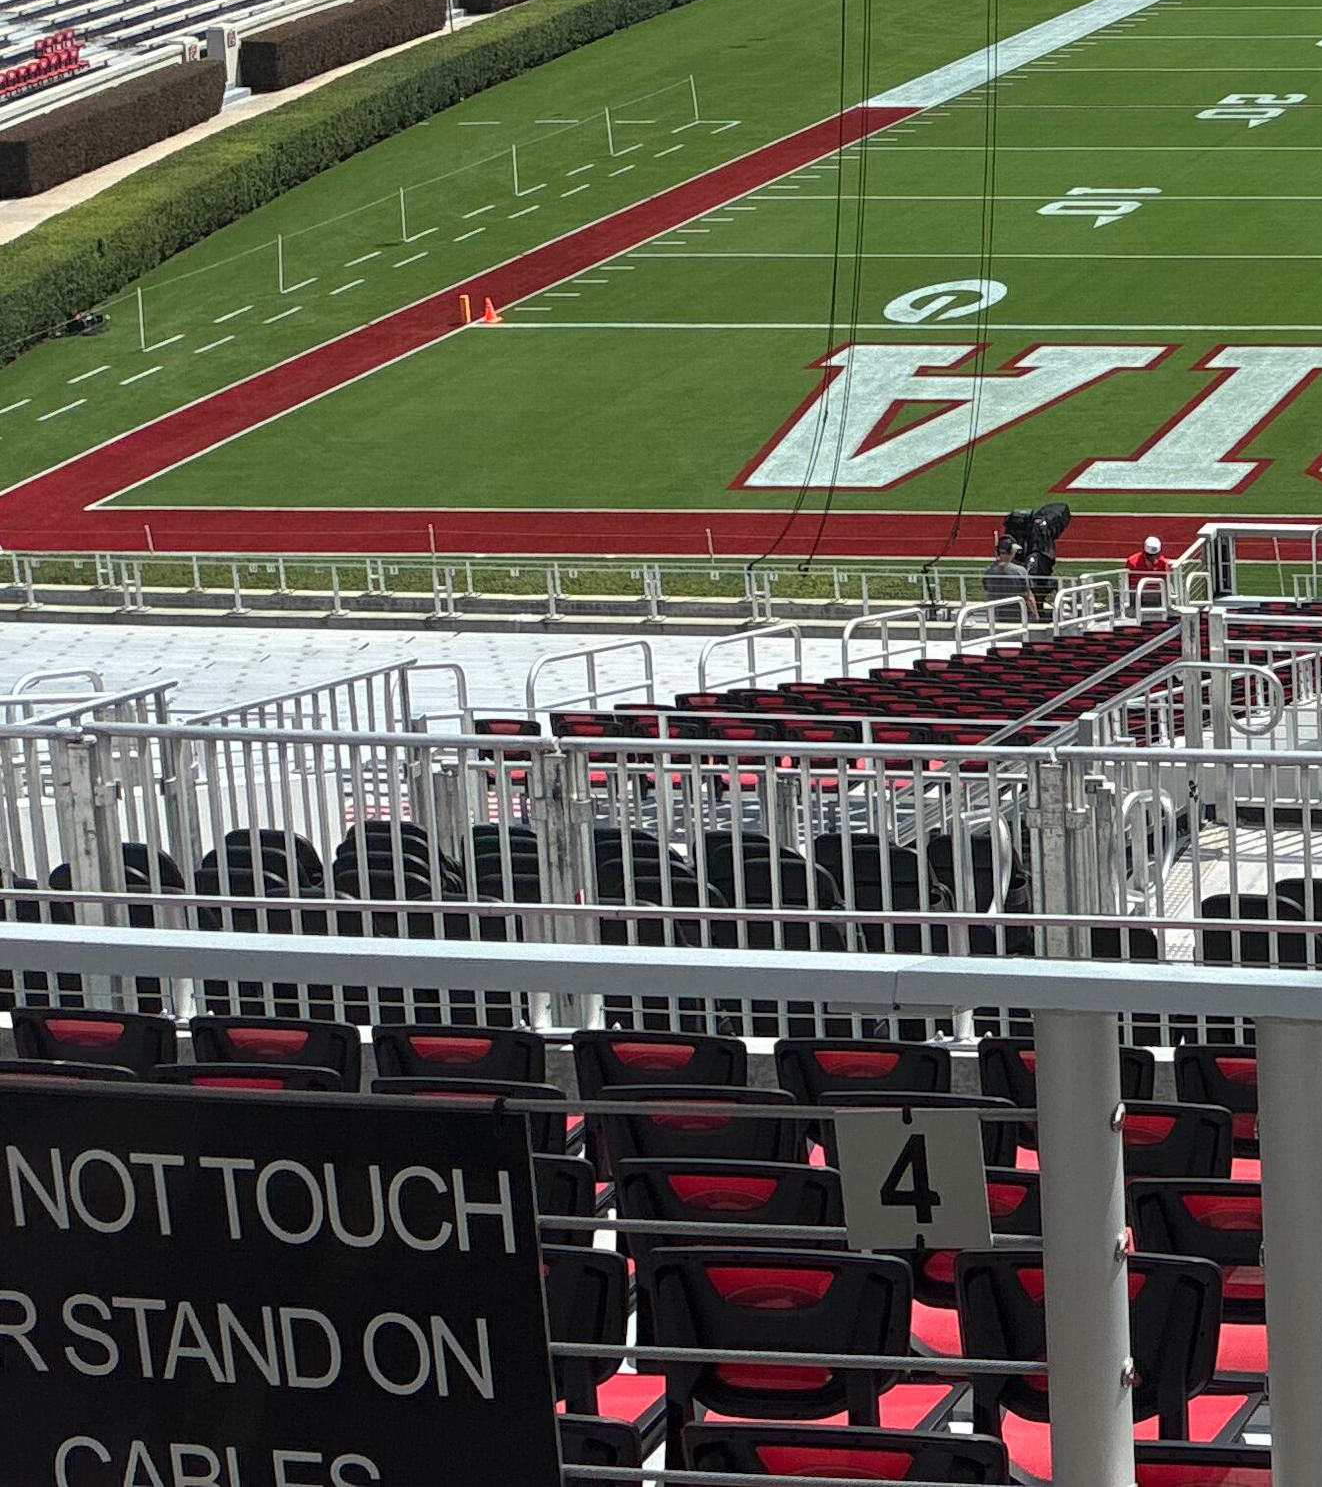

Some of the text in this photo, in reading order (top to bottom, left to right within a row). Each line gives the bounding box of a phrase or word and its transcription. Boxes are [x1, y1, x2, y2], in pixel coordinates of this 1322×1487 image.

[1195, 92, 1308, 121] 20
[1036, 185, 1163, 216] 10
[883, 278, 1008, 324] G
[5, 1145, 517, 1254] NOT TOUCH
[879, 1133, 942, 1224] 4
[62, 1293, 342, 1390] STAND
[363, 1312, 494, 1399] ON
